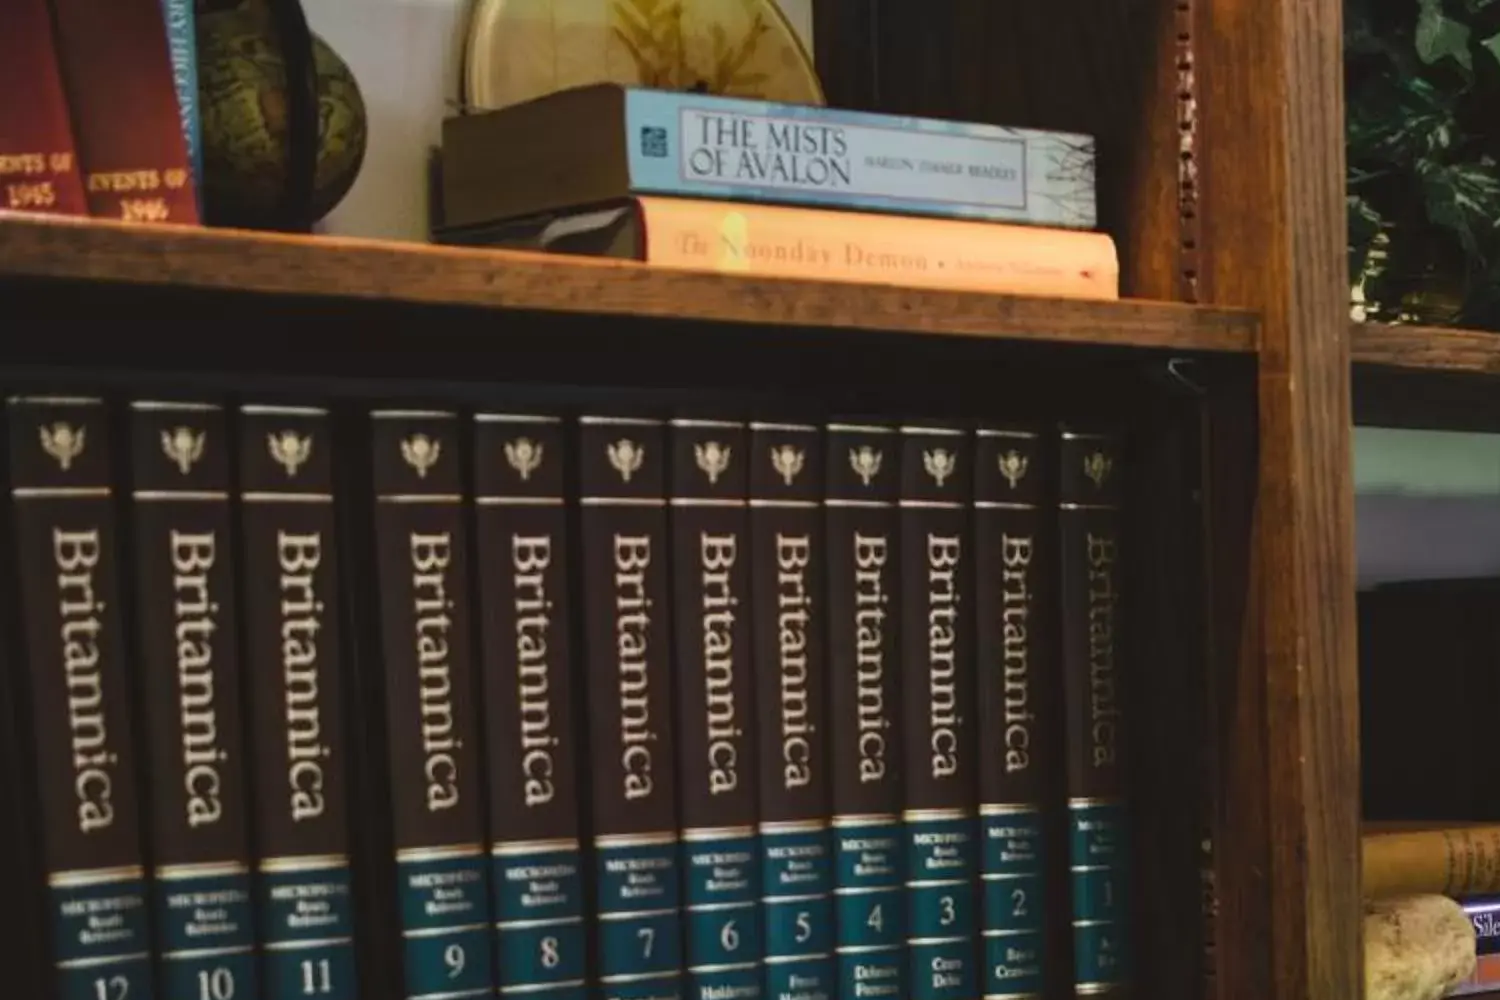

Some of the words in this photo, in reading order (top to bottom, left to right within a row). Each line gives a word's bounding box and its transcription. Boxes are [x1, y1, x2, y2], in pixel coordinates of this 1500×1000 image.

[689, 147, 726, 175] OF
[735, 151, 851, 187] AVALON
[700, 116, 757, 148] THE
[766, 128, 848, 155] MISTS
[845, 243, 929, 270] Demon
[51, 528, 117, 832] Britannica
[169, 530, 231, 828] Britannica
[276, 530, 332, 822] Britannica
[408, 531, 464, 812] Britannica
[510, 533, 557, 807] Britannica
[611, 534, 656, 800] Britannica
[699, 532, 746, 795] Britannica
[774, 534, 817, 790] Britannica
[853, 532, 889, 783] Britannica
[926, 534, 963, 780] Britannica
[1001, 534, 1039, 773] Britannica
[1086, 533, 1124, 768] Britannica
[445, 944, 466, 979] 9
[541, 936, 560, 969] 8
[638, 928, 656, 960] 7
[721, 921, 740, 951] 6
[795, 912, 812, 943] 5
[867, 904, 883, 933] 4
[940, 896, 955, 926] 3
[1011, 889, 1028, 917] 2
[301, 958, 331, 995] 11
